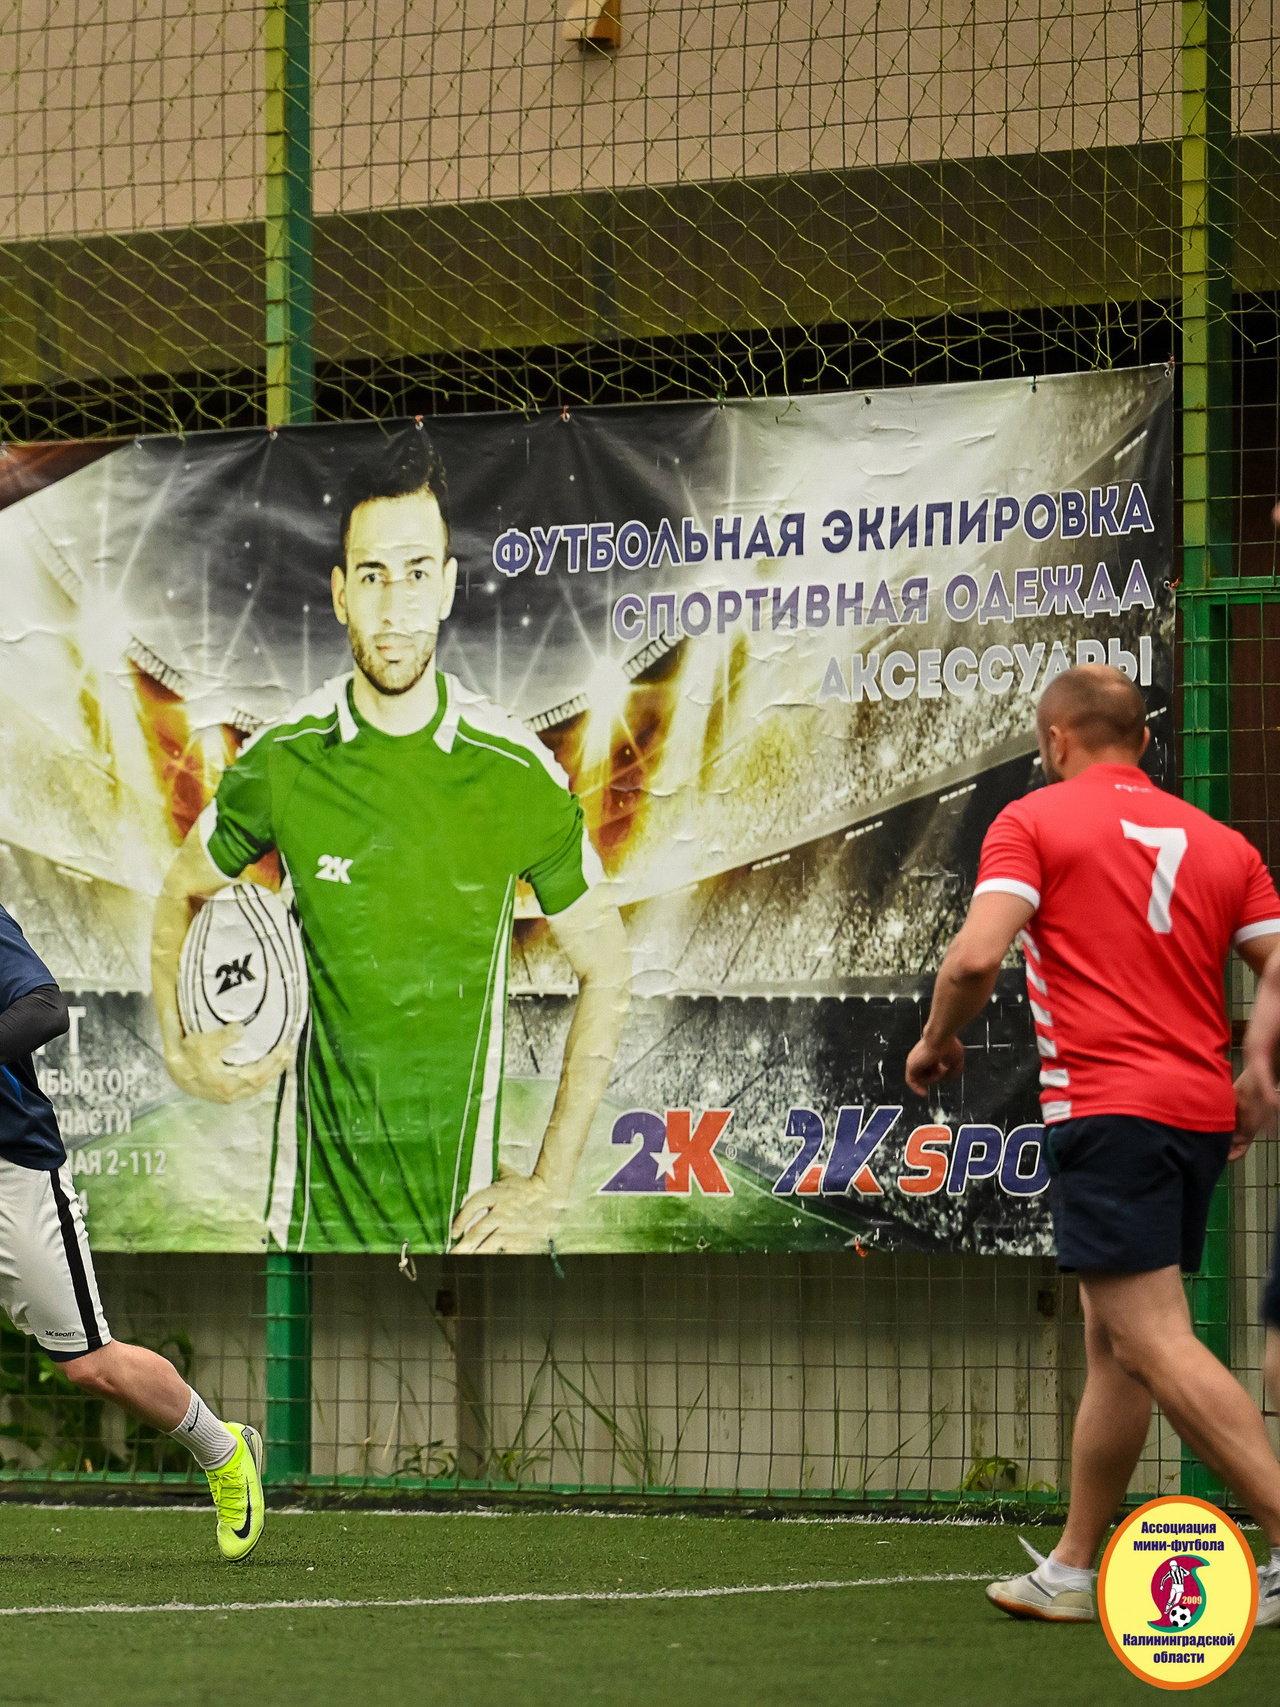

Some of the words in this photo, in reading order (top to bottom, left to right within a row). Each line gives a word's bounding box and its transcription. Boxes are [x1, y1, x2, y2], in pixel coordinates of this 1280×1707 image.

[492, 512, 806, 578] ФУТБОЛЬНАЯ
[819, 482, 1154, 554] ЭКИПИРОВКА
[612, 577, 929, 642] СПОРТИВНАЯ
[943, 560, 1155, 626] ОДЕЖДА
[1120, 818, 1188, 934] 7
[106, 1148, 167, 1176] 2-112
[897, 1123, 1051, 1197] SPO
